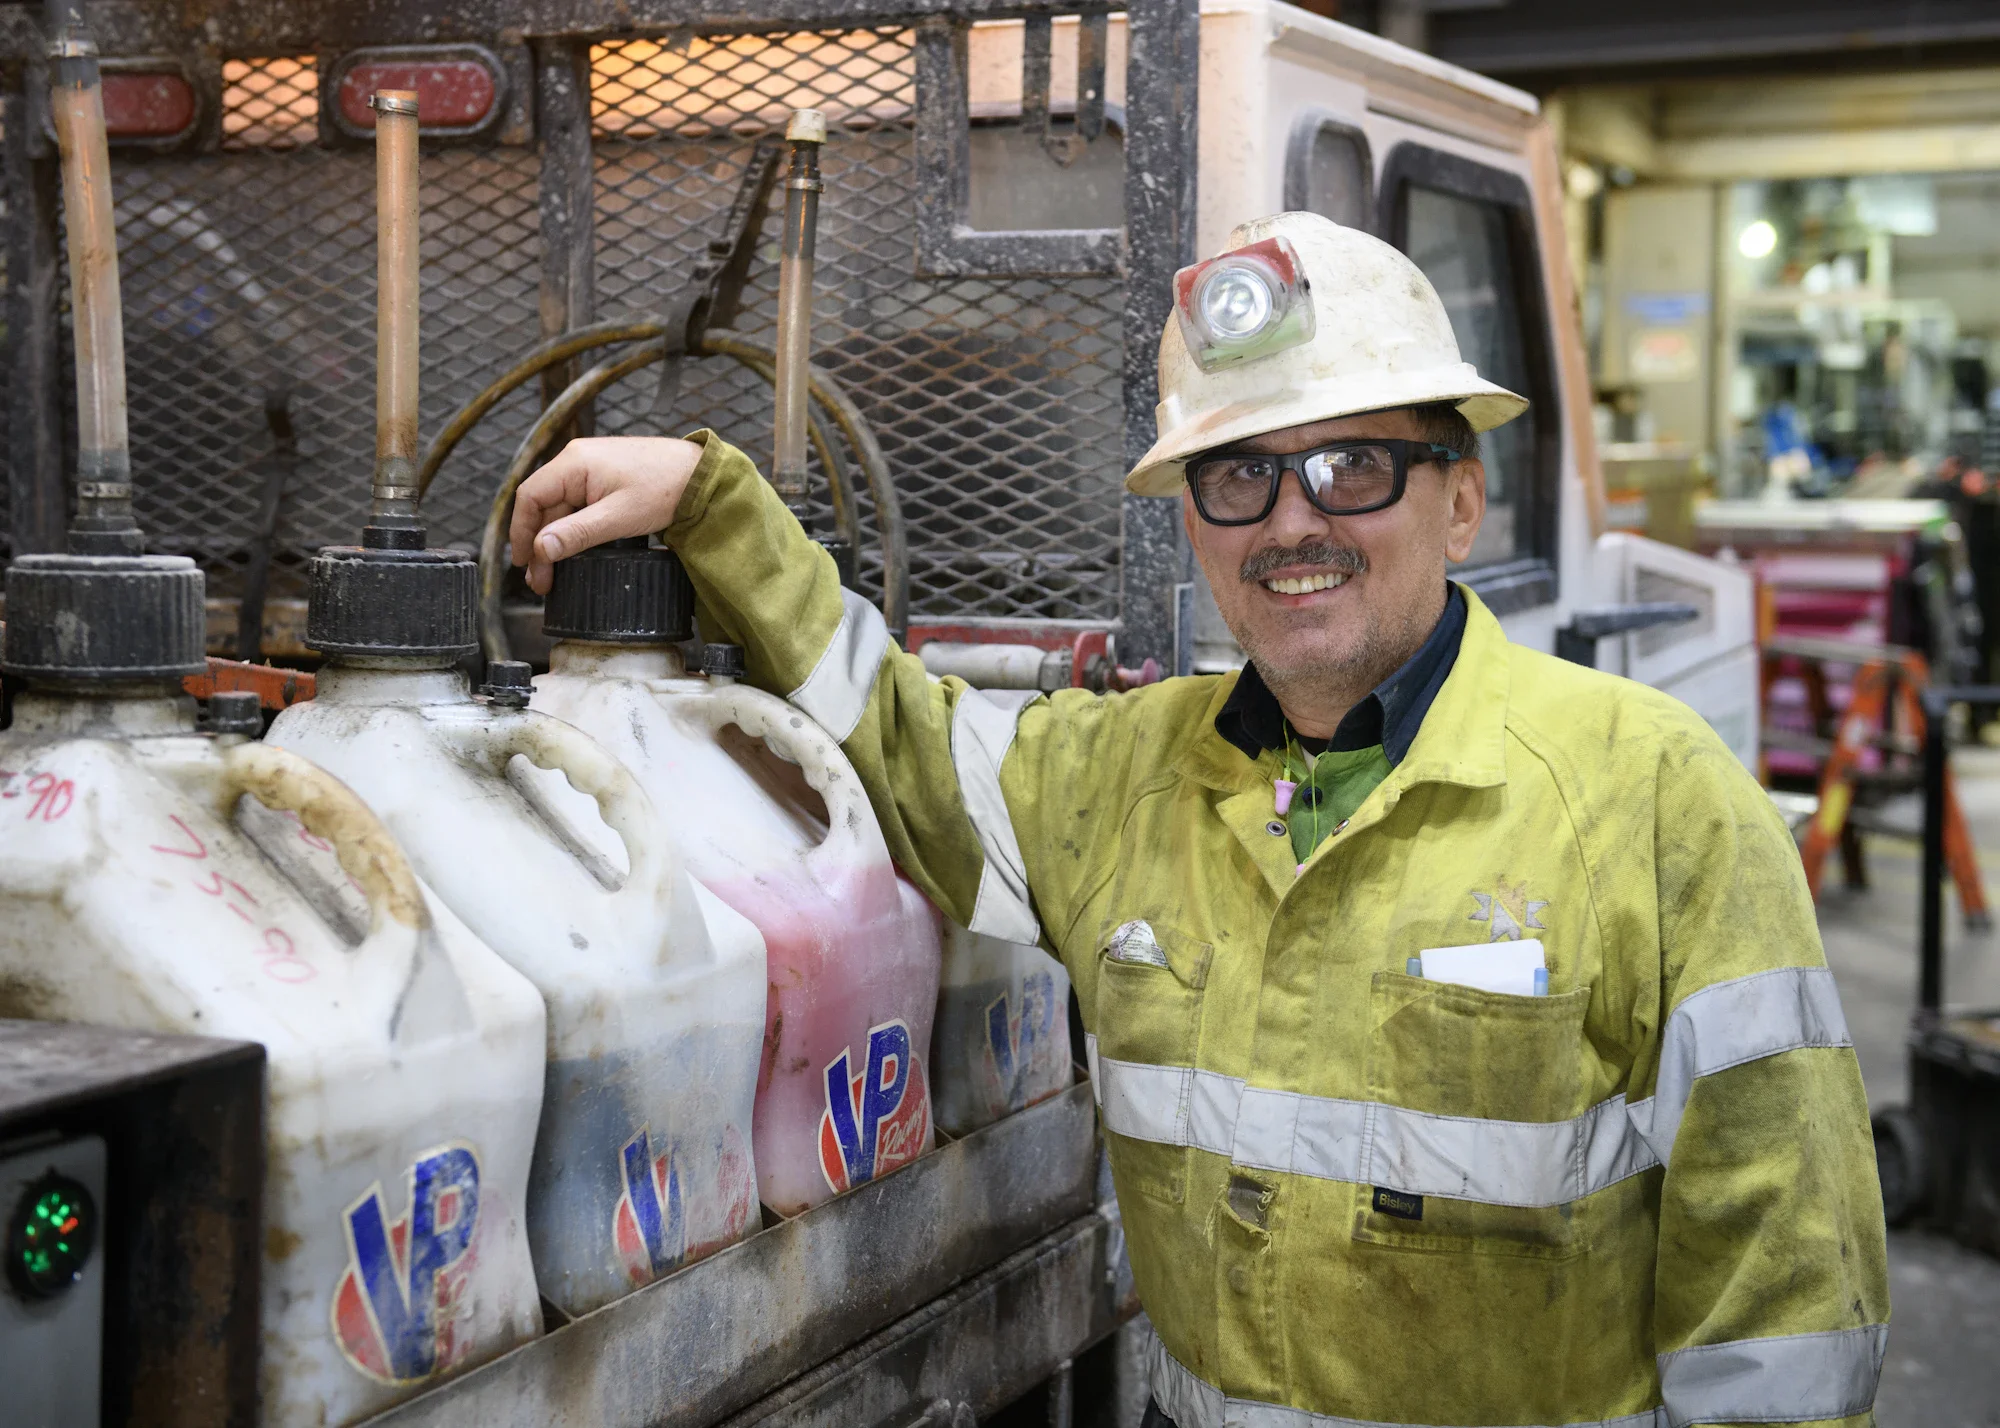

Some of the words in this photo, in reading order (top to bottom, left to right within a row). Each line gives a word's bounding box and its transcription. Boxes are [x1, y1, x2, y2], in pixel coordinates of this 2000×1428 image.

[823, 1018, 911, 1190] VP
[880, 1097, 928, 1175] Racing
[341, 1137, 483, 1383] VP
[1378, 1192, 1416, 1215] Bisley
